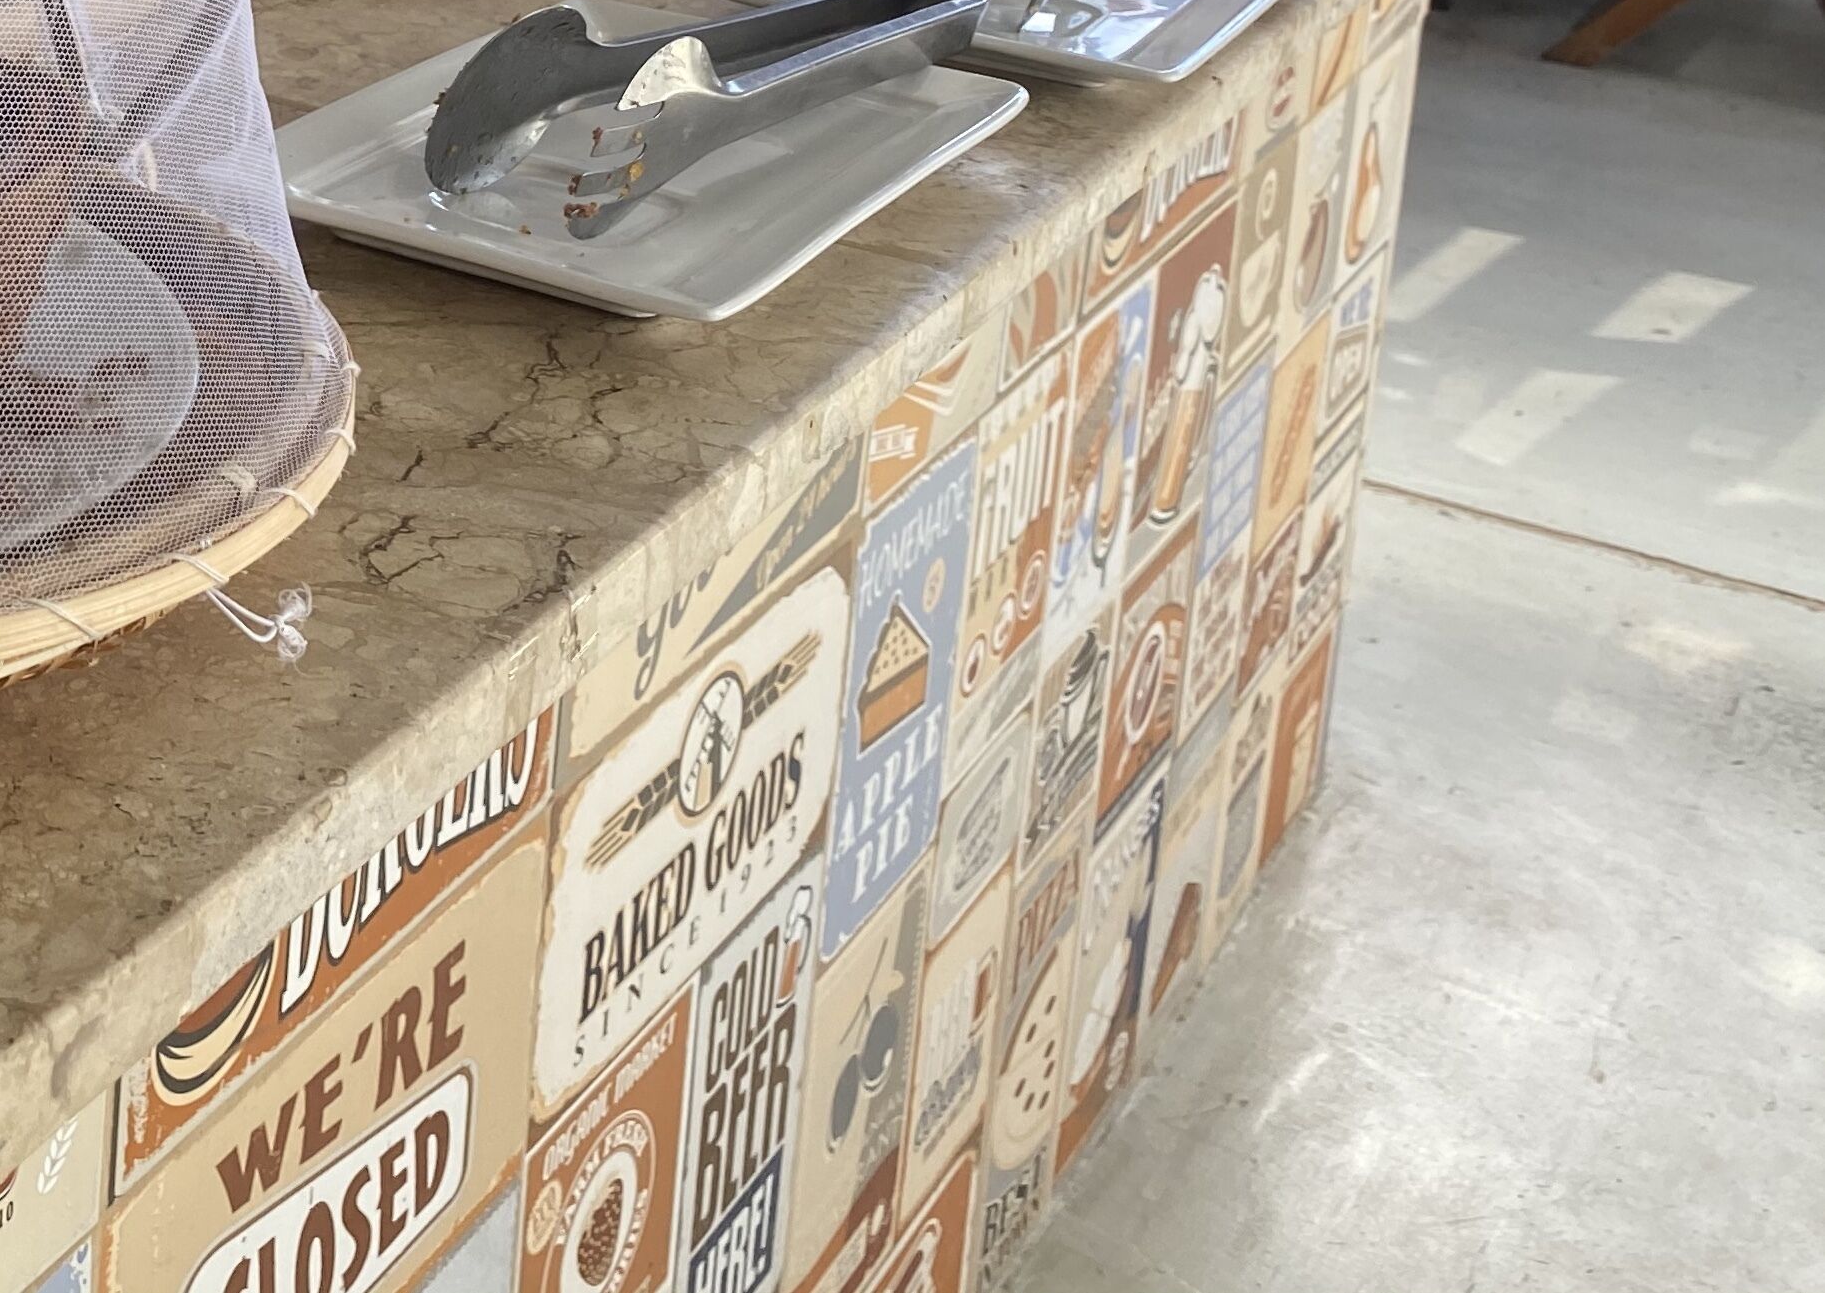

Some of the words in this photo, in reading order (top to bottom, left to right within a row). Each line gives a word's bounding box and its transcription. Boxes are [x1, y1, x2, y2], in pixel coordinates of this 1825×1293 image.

[974, 396, 1066, 578] FRUIT
[578, 841, 696, 1025] BAKED
[704, 727, 805, 892] GOODS
[835, 704, 944, 863] APPLE
[850, 794, 913, 904] PIE
[573, 915, 701, 1067] SINCE
[719, 815, 778, 914] 1923
[706, 925, 780, 1094] COLD
[216, 938, 466, 1213] WE'RE
[690, 1003, 797, 1252] BEER
